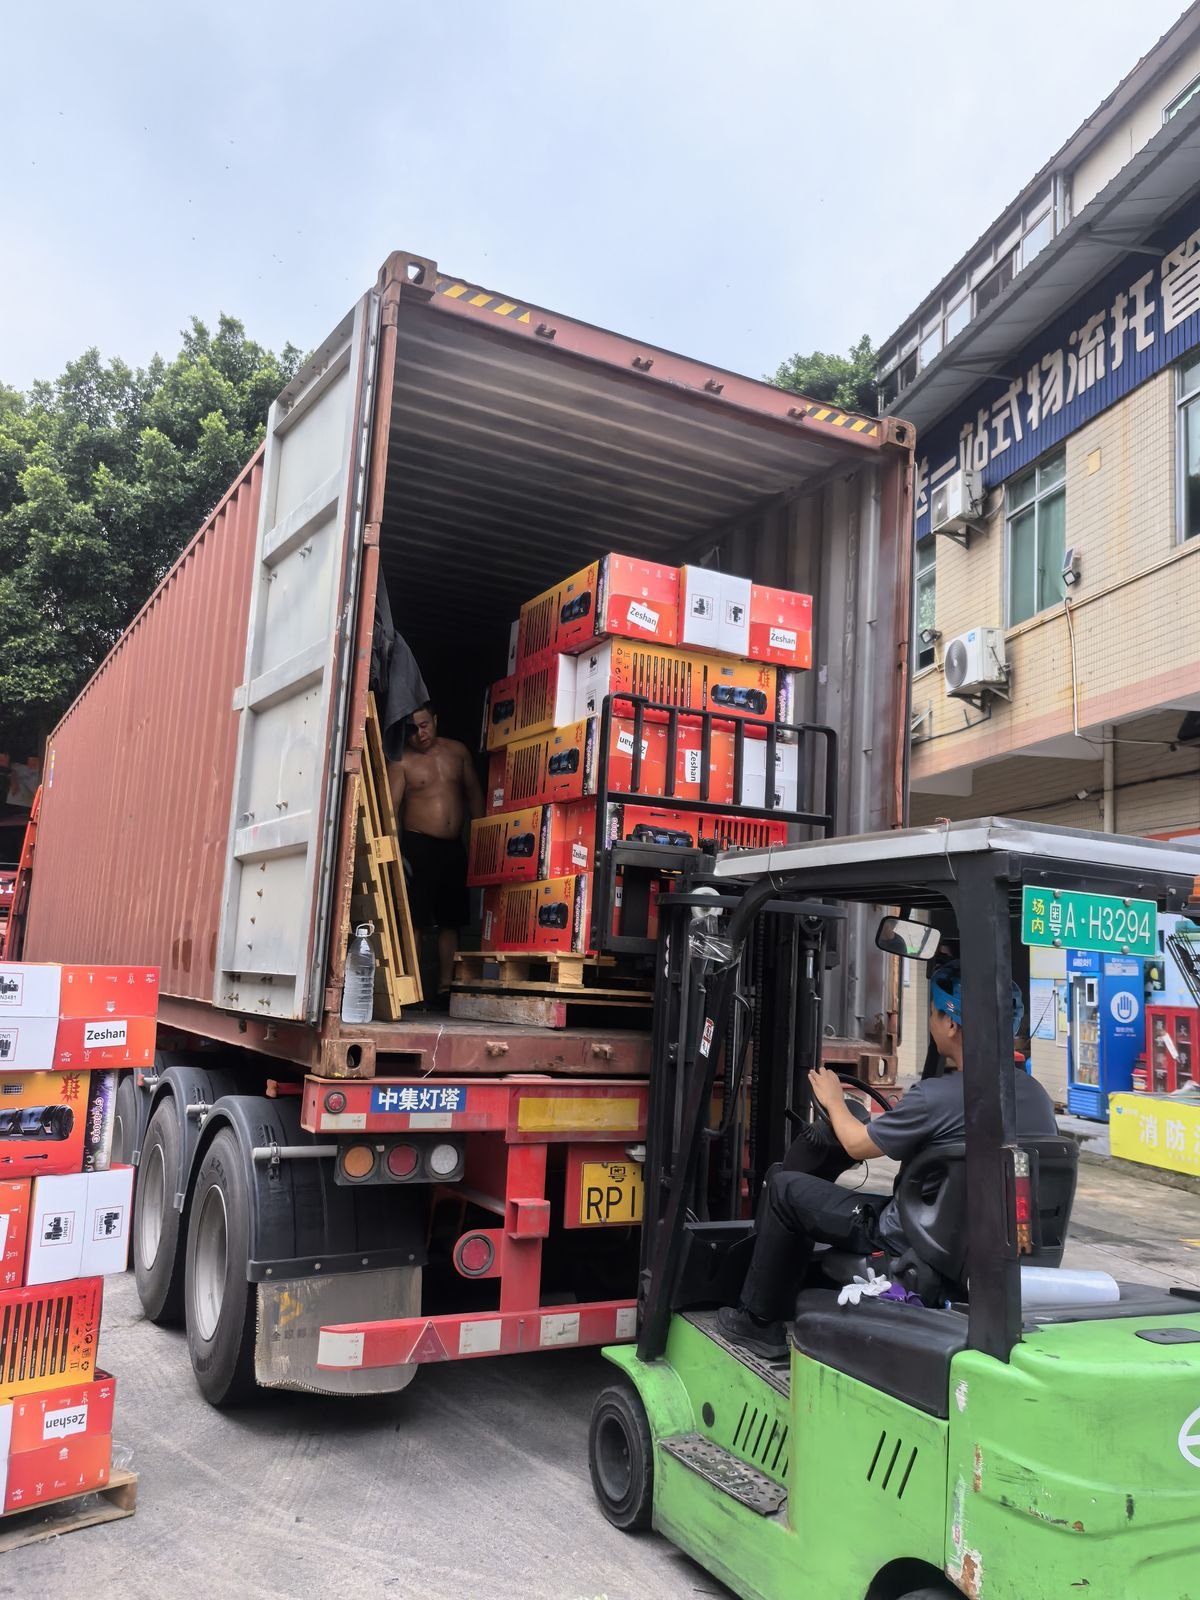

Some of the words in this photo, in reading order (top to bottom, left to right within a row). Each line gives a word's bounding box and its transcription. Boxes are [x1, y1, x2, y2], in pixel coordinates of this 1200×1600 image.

[630, 607, 656, 627] Zeshan
[771, 633, 796, 645] Zeshan
[619, 736, 646, 754] Zhan
[690, 751, 698, 782] Zeshan
[1031, 898, 1045, 935] 场内
[1049, 900, 1151, 945] 粤A·H3294
[86, 1029, 126, 1041] Zeshan
[378, 1088, 460, 1111] 中集灯塔
[45, 1413, 86, 1429] Zeshan
